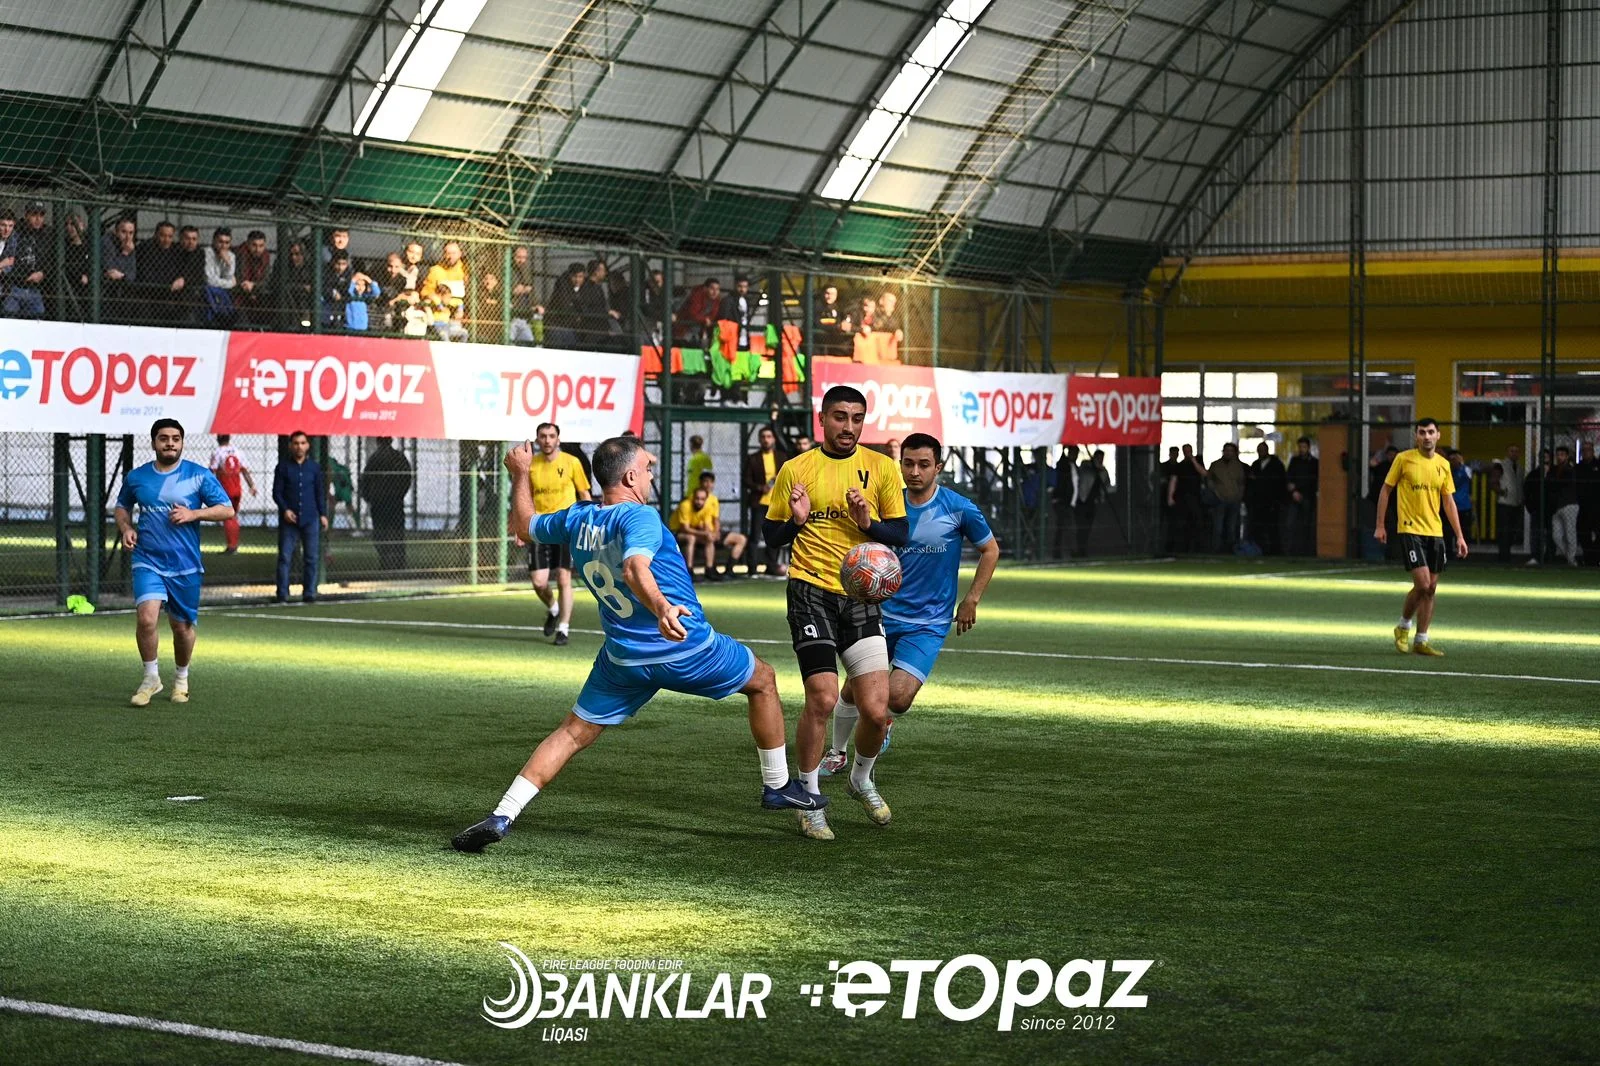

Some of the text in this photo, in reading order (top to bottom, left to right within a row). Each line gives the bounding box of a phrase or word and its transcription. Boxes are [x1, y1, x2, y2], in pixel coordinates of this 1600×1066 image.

[0, 347, 197, 413] eTOpaz
[251, 356, 426, 419] eTOpaz
[961, 389, 1054, 433] eTOpaz
[1077, 390, 1161, 433] eTOpaz
[808, 506, 848, 522] yelob
[899, 543, 948, 554] AccessBank
[1409, 550, 1418, 563] 8
[583, 560, 634, 619] 8
[803, 624, 818, 638] 9
